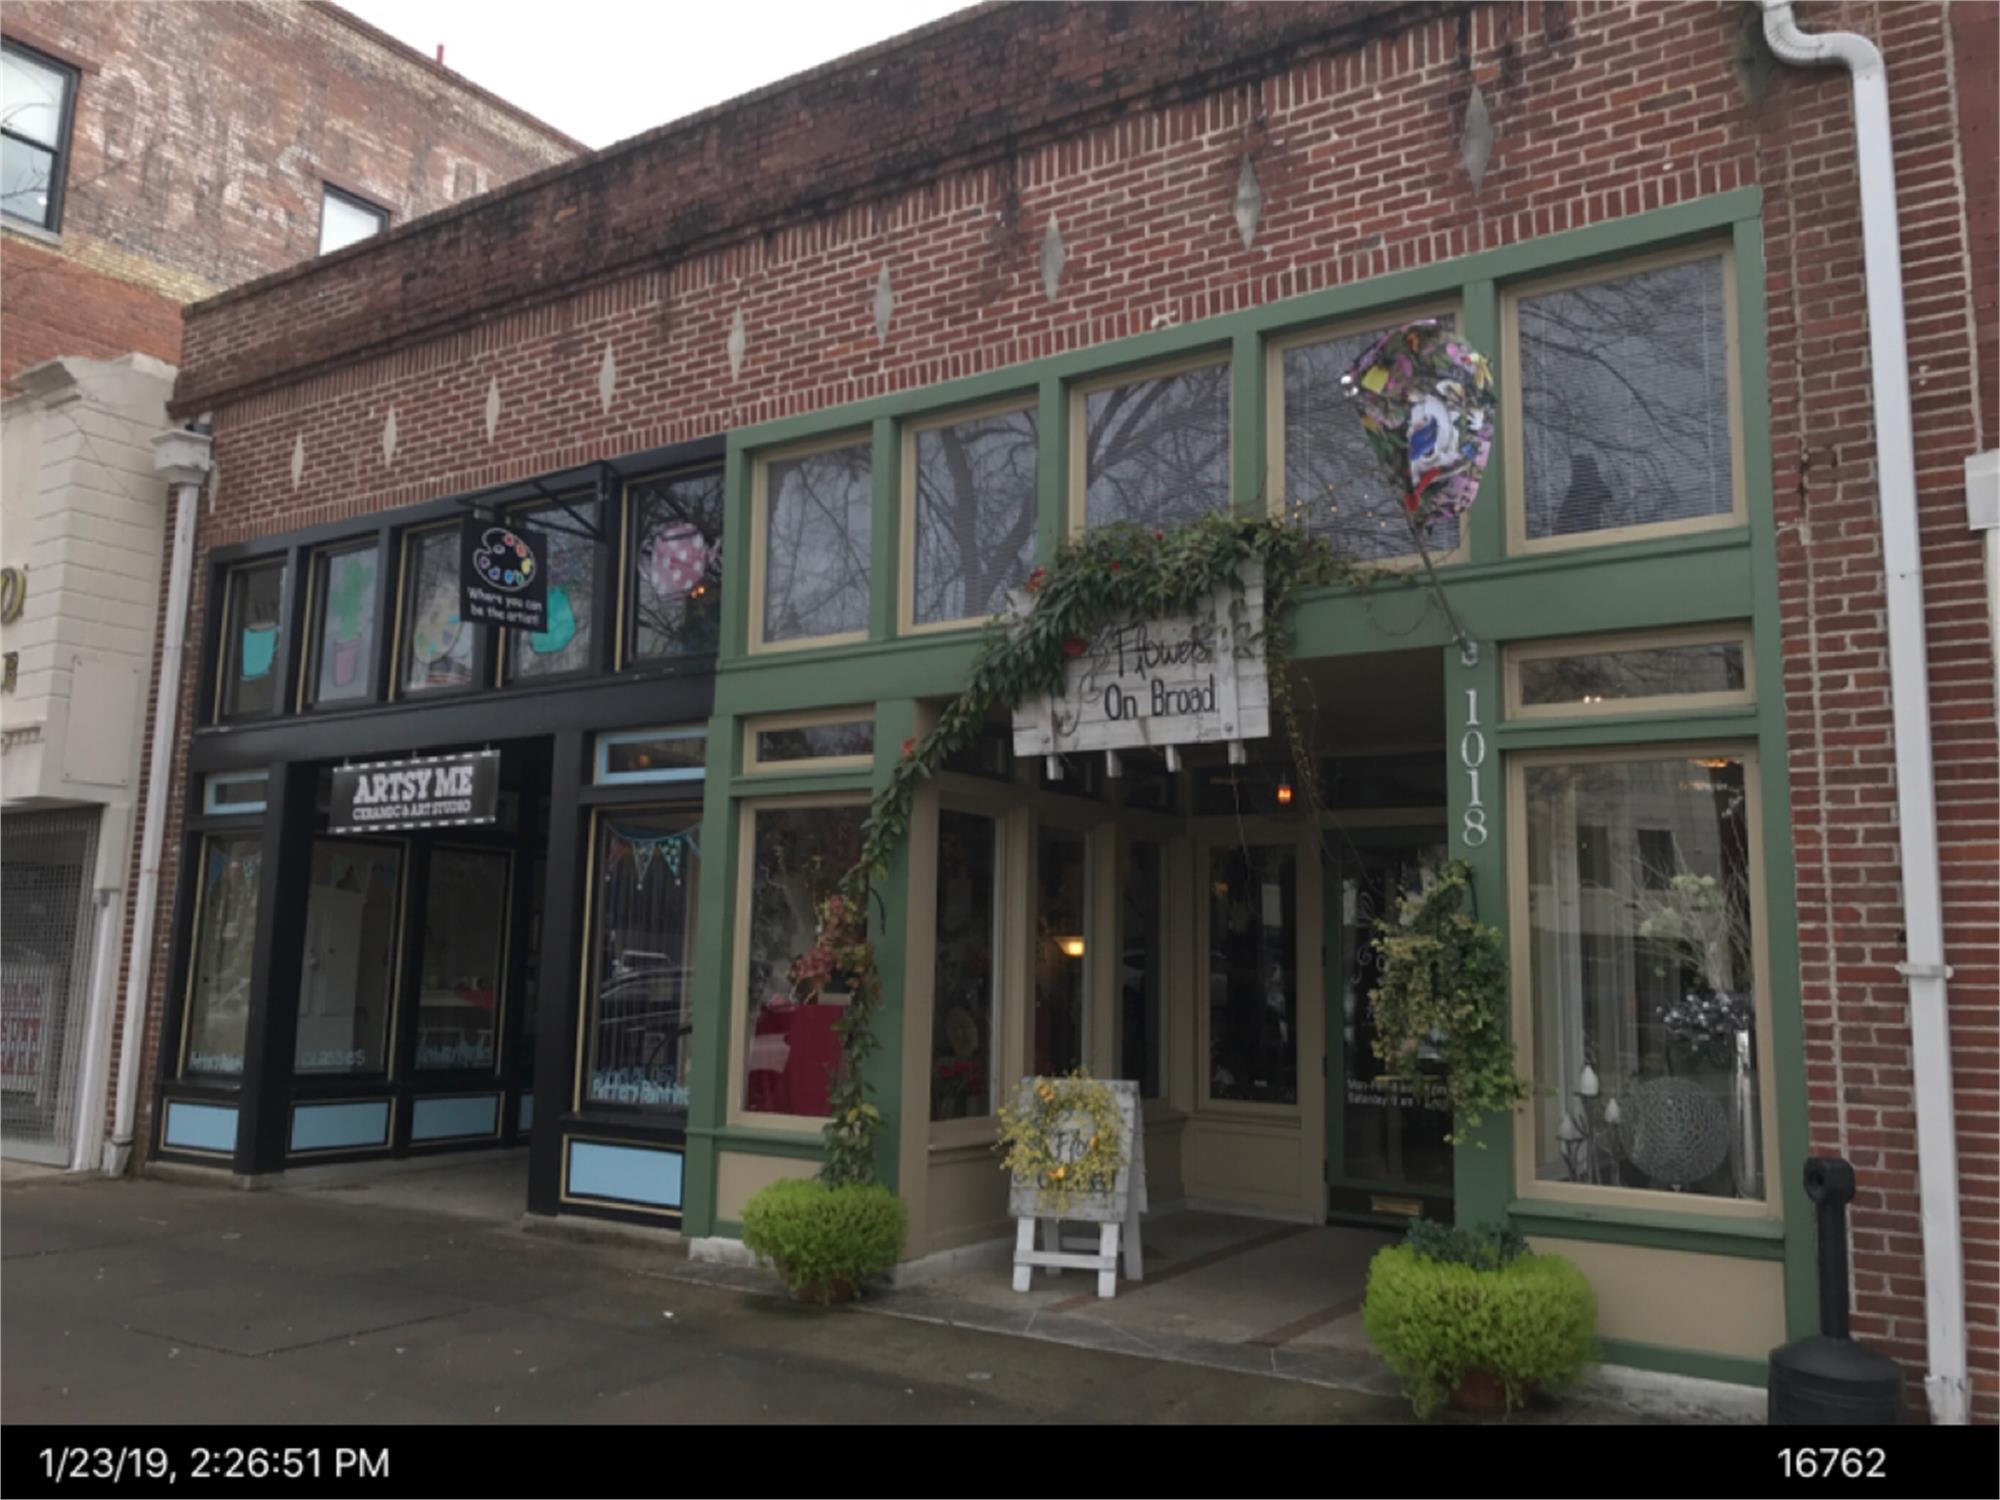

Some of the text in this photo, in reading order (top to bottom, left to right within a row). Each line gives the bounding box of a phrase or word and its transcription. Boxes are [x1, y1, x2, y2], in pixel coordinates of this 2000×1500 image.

[467, 586, 543, 612] Where you can
[470, 603, 484, 617] be
[487, 606, 505, 620] the
[1104, 673, 1216, 721] On Broad
[1460, 688, 1488, 847] 1018
[352, 766, 474, 804] ARTSY ME
[352, 805, 401, 820] CERAMIC
[410, 802, 431, 816] ART
[431, 799, 472, 815] STUDIO
